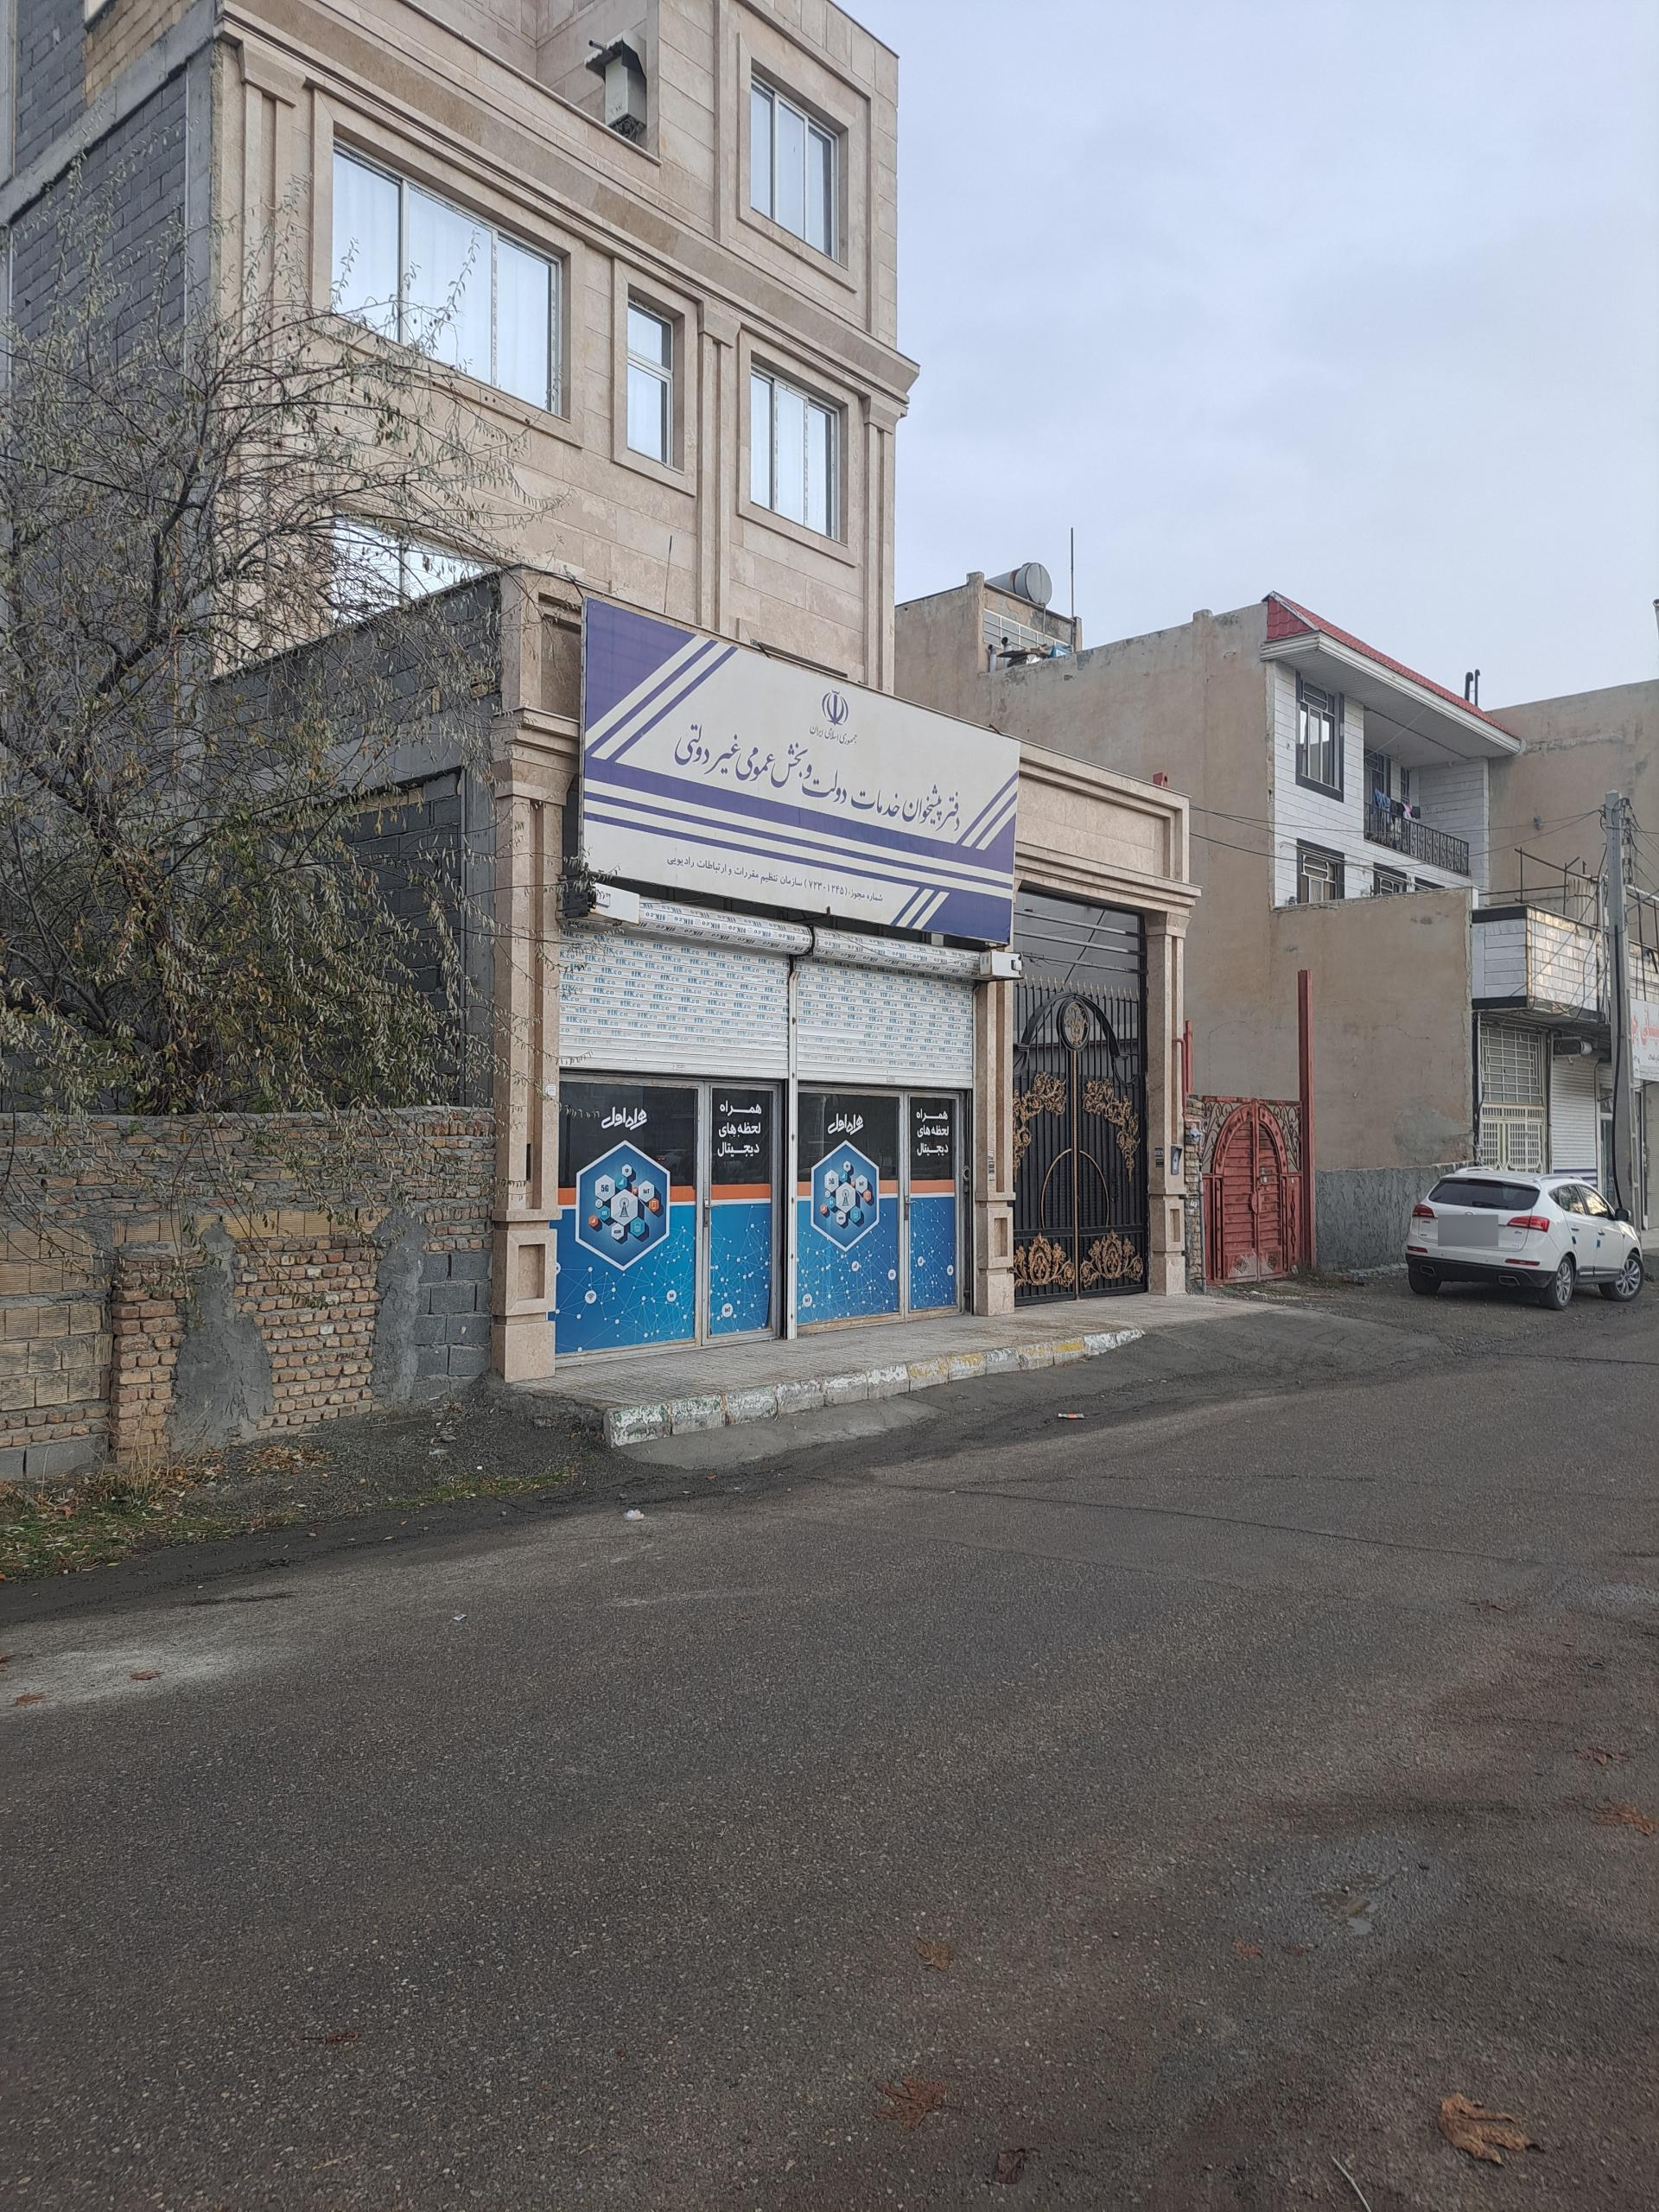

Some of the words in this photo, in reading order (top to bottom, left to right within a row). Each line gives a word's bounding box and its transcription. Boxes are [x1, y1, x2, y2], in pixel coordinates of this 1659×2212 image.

[809, 725, 824, 738] ایران
[824, 728, 839, 741] اسلامی
[674, 724, 710, 766] دولتی
[838, 733, 858, 746] جمهوری
[703, 734, 741, 774] غیر
[735, 747, 775, 782] عمومی
[771, 741, 809, 788] بخش
[803, 764, 812, 780] و
[802, 769, 847, 804] دولت
[850, 788, 900, 817] خدمات
[902, 783, 943, 826] پیشخوان
[935, 791, 960, 832] دفتر
[667, 856, 695, 868] رادیویی
[696, 861, 728, 874] ارتباطات
[734, 867, 760, 880] مقررات
[760, 872, 779, 884] تنظیم
[779, 875, 804, 887] سازمان
[866, 892, 884, 902] شماره
[717, 1141, 760, 1158] دیجیتال
[916, 1142, 949, 1157] دیجیتال
[601, 1184, 609, 1192] 5G
